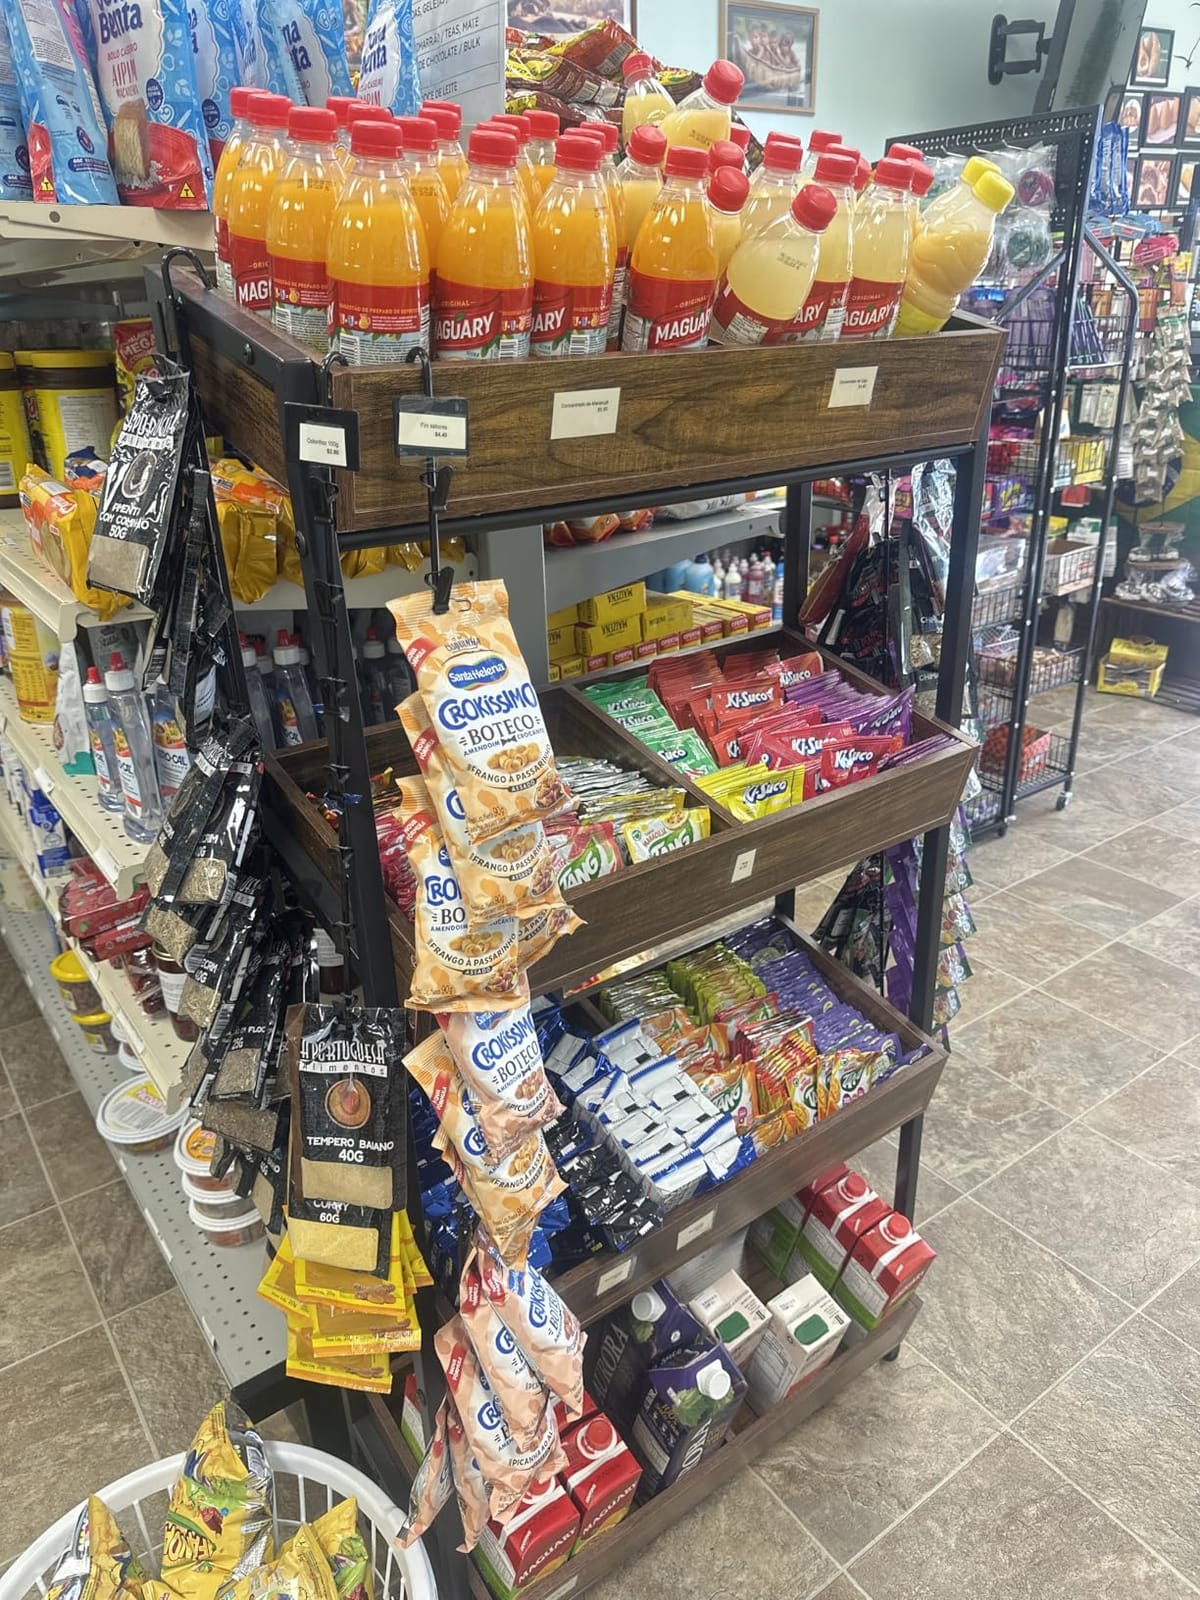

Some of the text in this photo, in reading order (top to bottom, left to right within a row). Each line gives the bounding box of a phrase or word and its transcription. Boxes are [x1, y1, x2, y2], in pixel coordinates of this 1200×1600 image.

[98, 2, 143, 44] Benta
[462, 16, 480, 30] MATE
[426, 45, 458, 67] CHOCOLATE
[463, 37, 481, 52] BULK
[655, 306, 713, 344] MAGUAR
[725, 690, 768, 710] Ki-Suco
[467, 713, 535, 747] BOTECO
[463, 740, 501, 757] AMENDOIM
[834, 748, 874, 770] Ki-Suco
[472, 765, 506, 784] FRANGO
[515, 743, 551, 782] PASSARINHO
[742, 778, 788, 804] Ki-Suco
[472, 854, 509, 873] FRANGO
[558, 850, 600, 891] TANG
[429, 941, 465, 967] FRANGO
[473, 933, 517, 968] PASSARINHO
[311, 1039, 386, 1064] PORTUGUESA
[496, 1040, 539, 1084] BOTECO
[306, 1136, 395, 1151] TEMPERO BAIANO
[338, 1149, 365, 1162] 40G
[319, 1212, 340, 1224] 60G
[582, 1482, 638, 1536] MAGUARY
[518, 1527, 577, 1584] MAGUARY
